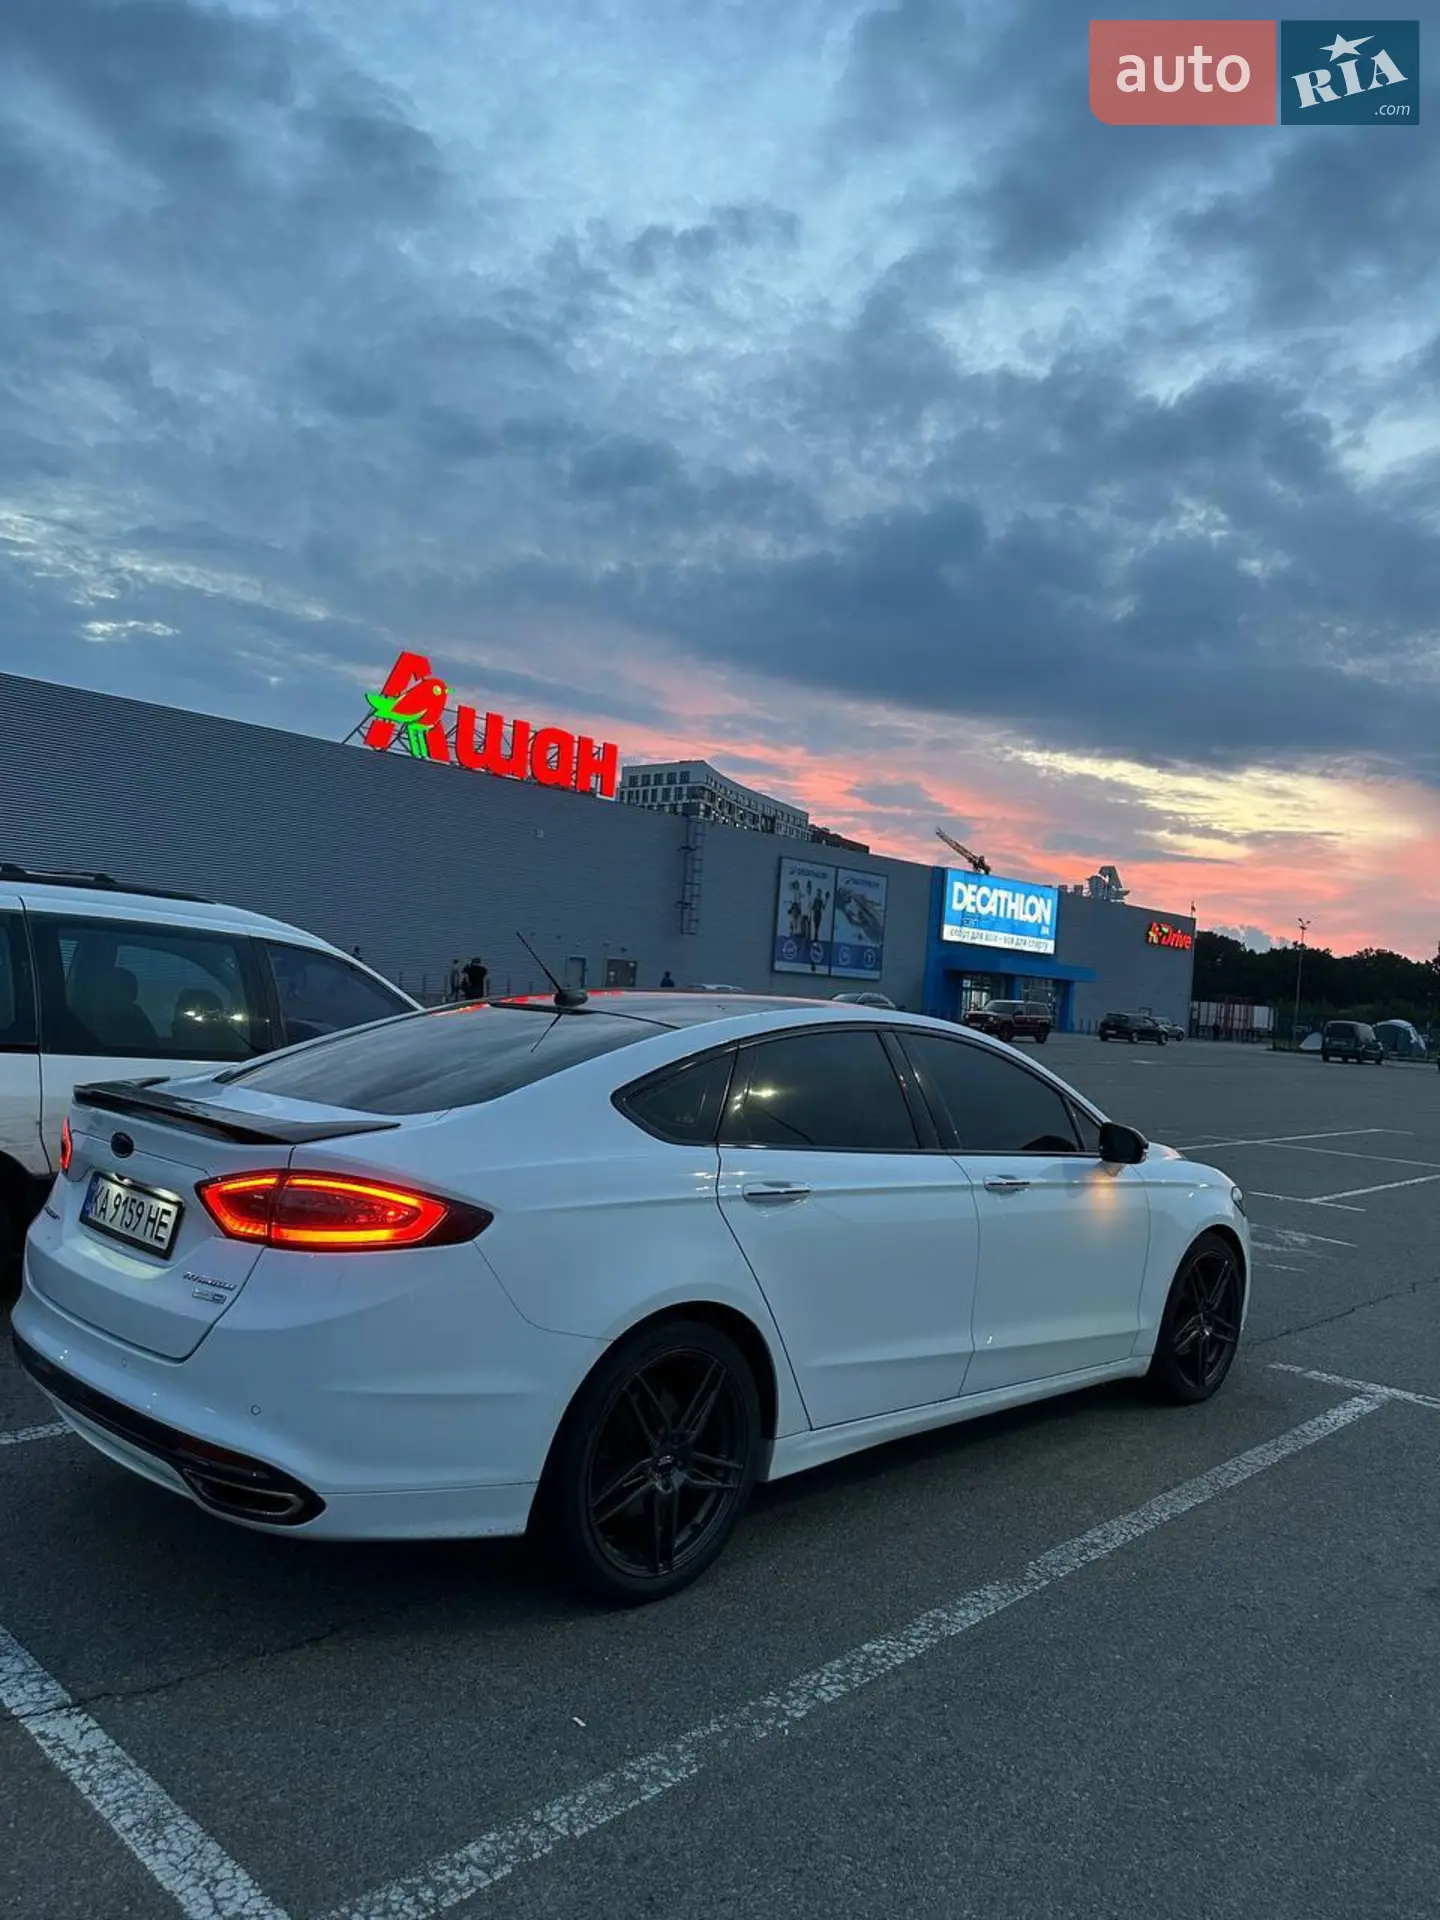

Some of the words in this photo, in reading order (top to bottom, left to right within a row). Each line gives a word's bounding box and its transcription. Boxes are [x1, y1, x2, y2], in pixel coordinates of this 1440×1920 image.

[951, 881, 1053, 926] DECATHLON
[1159, 922, 1192, 949] Drive
[109, 1192, 145, 1232] 9159
[143, 1204, 172, 1243] HE
